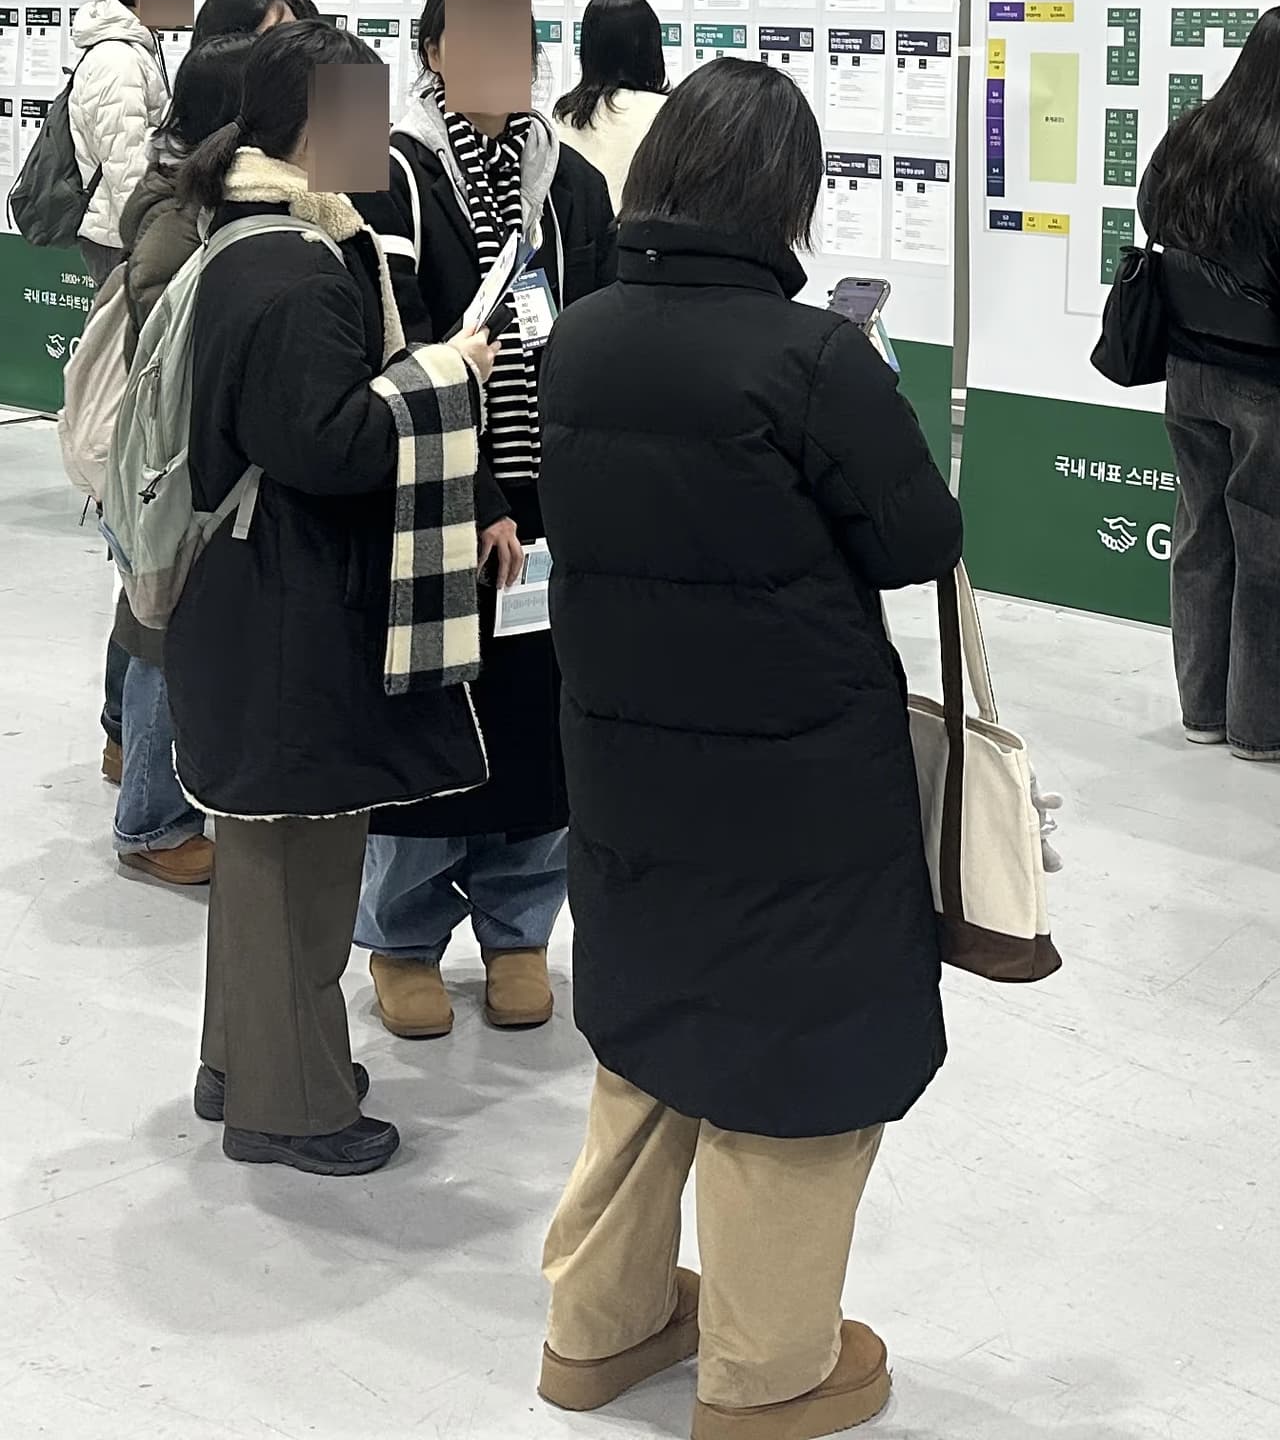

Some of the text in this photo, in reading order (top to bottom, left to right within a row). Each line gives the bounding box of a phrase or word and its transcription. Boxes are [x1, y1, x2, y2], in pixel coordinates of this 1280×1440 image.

[23, 288, 89, 312] 국내 대표 스타트업
[1055, 456, 1178, 491] 국내 대표 스타트
